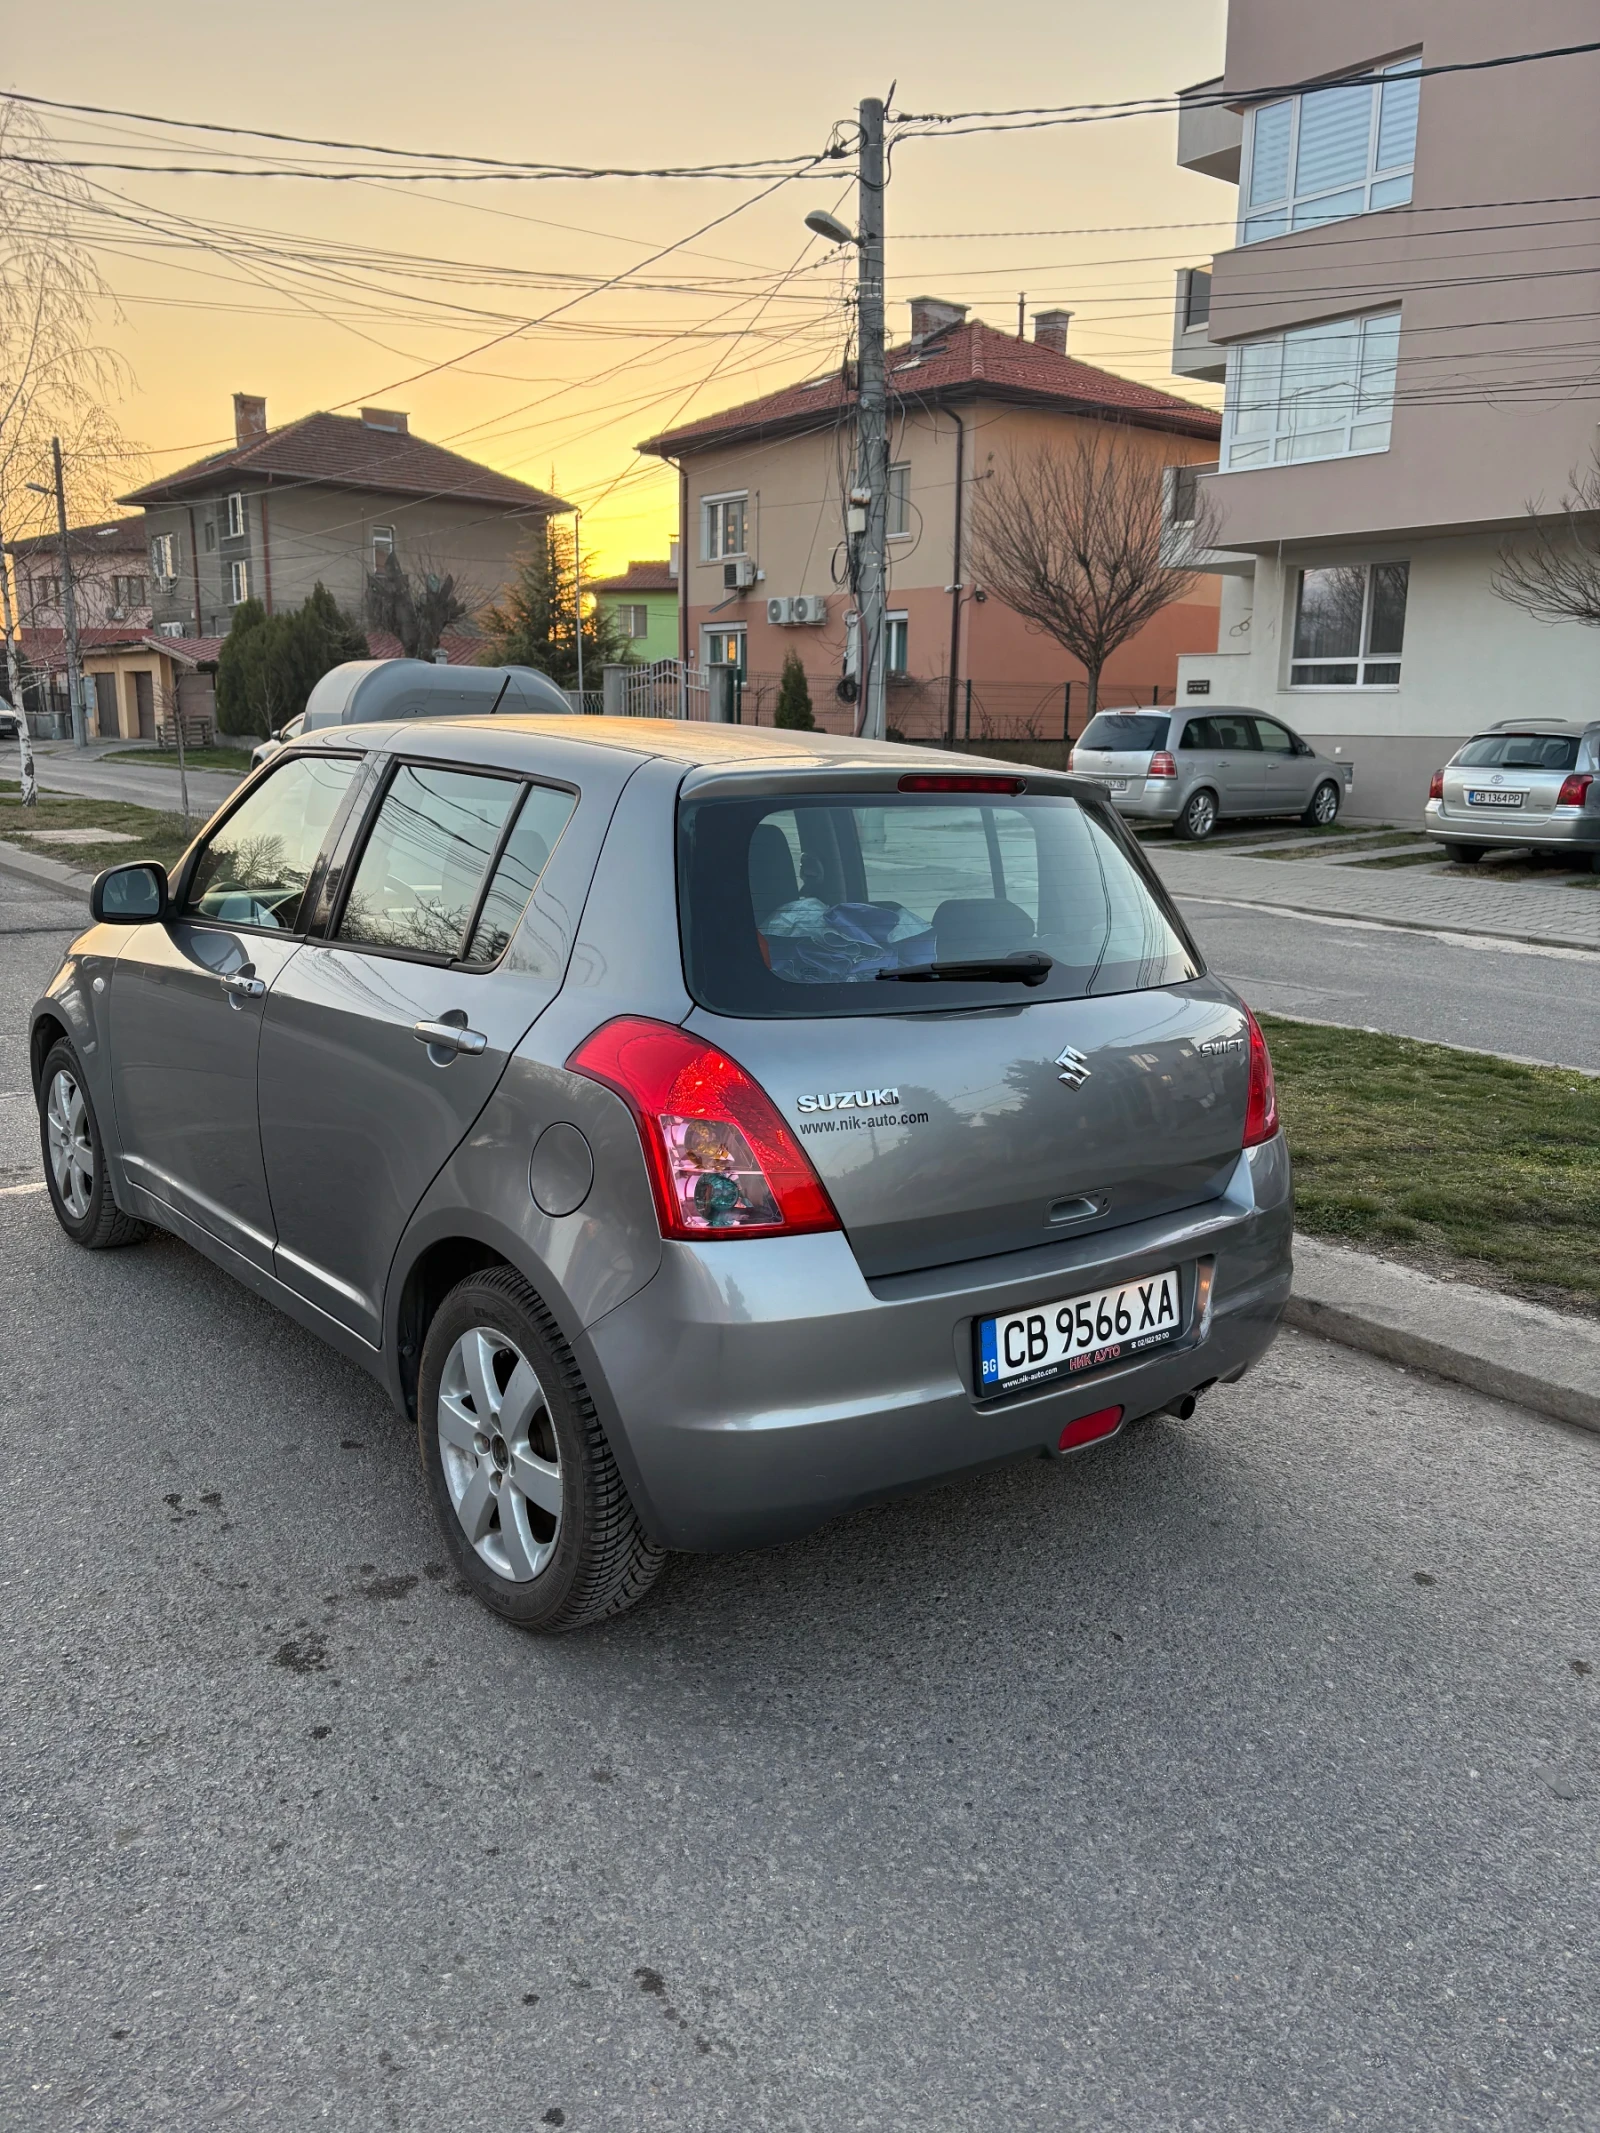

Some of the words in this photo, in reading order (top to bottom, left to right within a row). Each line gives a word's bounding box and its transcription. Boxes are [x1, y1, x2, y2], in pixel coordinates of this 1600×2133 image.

[1474, 792, 1486, 802] CB
[1488, 793, 1507, 803] 1364
[1508, 794, 1520, 803] PP
[1200, 1038, 1244, 1059] SWIFT
[797, 1087, 900, 1113] SUZUKI
[800, 1112, 929, 1135] www.nik-auto.com
[1004, 1314, 1048, 1369] CB
[1055, 1291, 1132, 1354] 9566
[1138, 1279, 1174, 1331] XA
[982, 1358, 997, 1376] BG
[1069, 1352, 1092, 1371] НИК
[1093, 1344, 1121, 1363] АУТО
[1002, 1366, 1058, 1389] www.nik-auto.com
